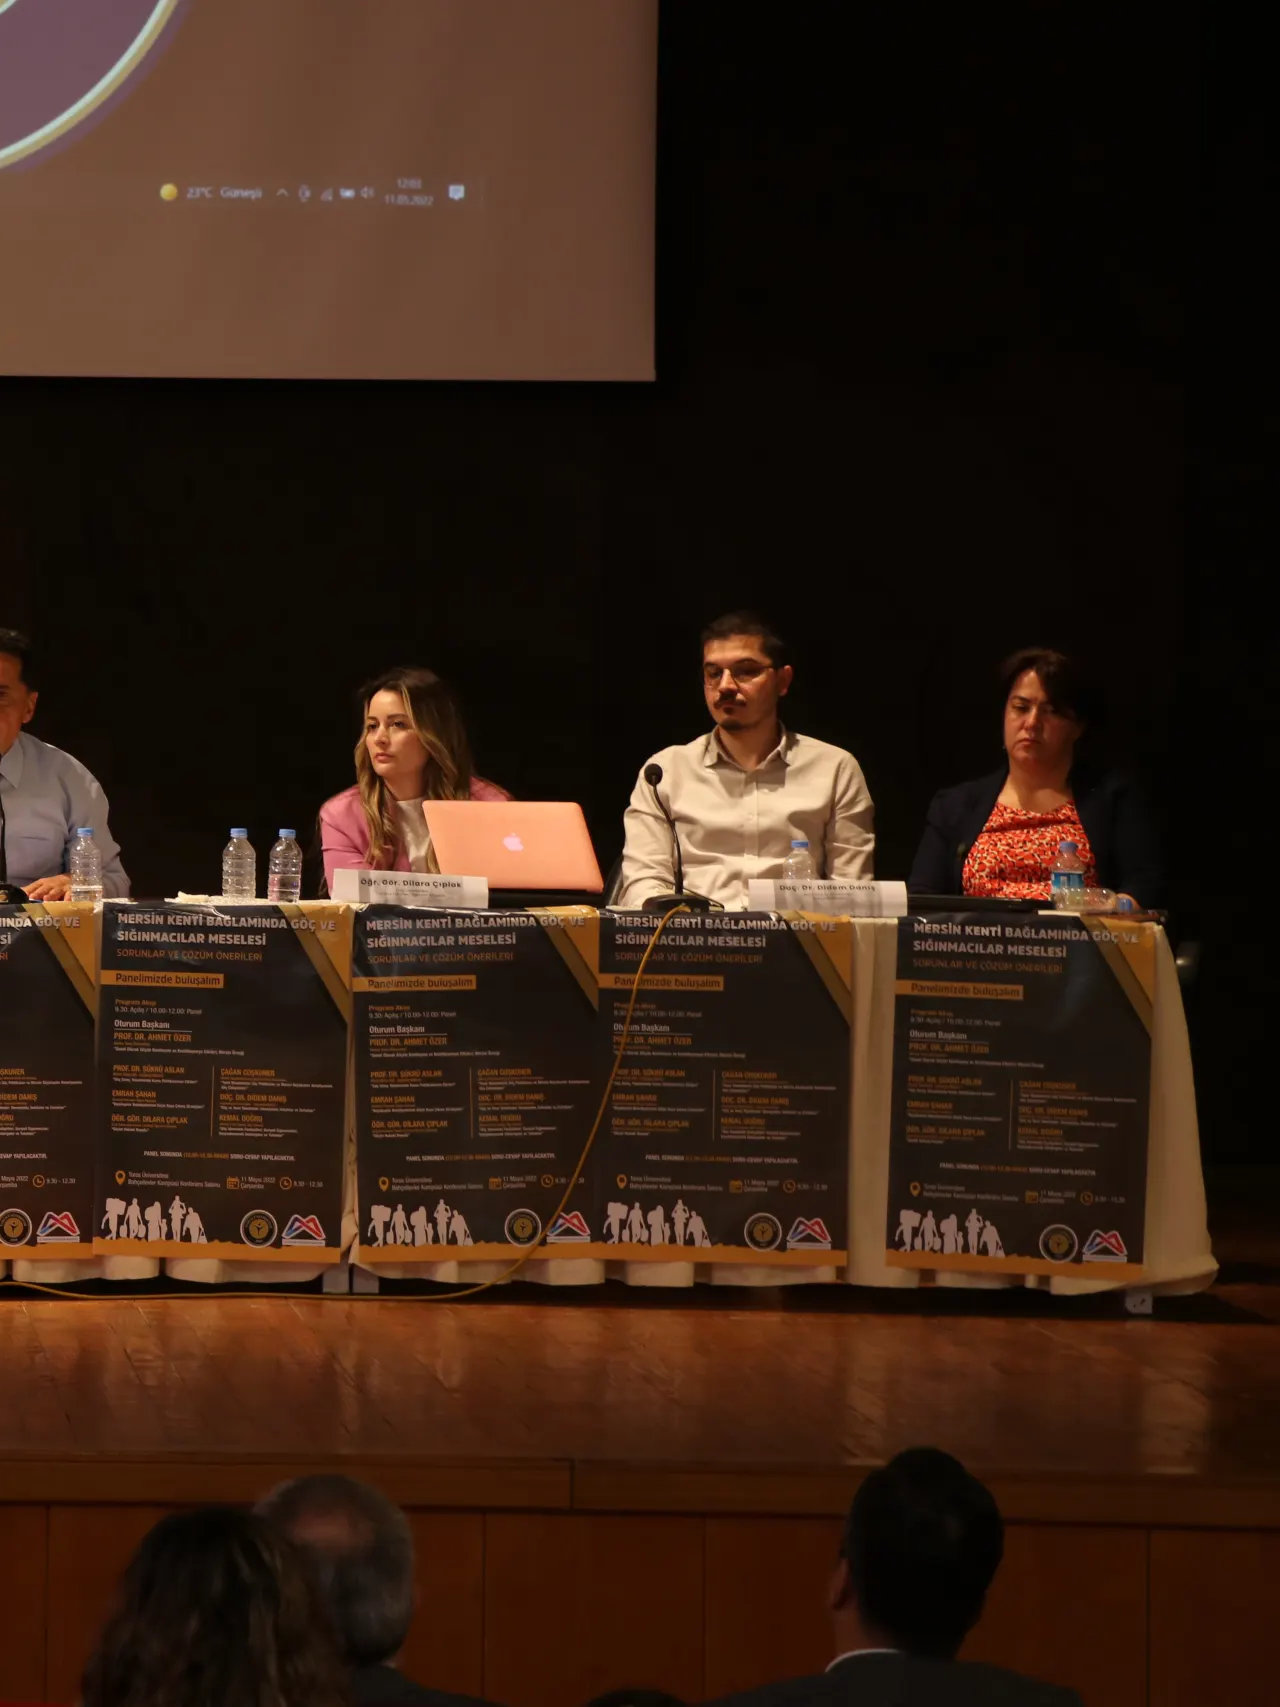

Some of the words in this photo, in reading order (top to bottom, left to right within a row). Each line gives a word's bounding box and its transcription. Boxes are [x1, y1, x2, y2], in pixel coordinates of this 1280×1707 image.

[403, 879, 430, 887] Dilara
[433, 881, 461, 889] Çıplak
[36, 916, 61, 930] GÖÇ
[64, 917, 80, 928] VE
[118, 912, 165, 925] MERSİN
[167, 914, 203, 926] KENTİ
[206, 915, 287, 929] BAĞLAMINDA
[291, 918, 316, 933] GÖÇ
[321, 920, 336, 930] VE
[367, 917, 412, 931] MERSİN
[416, 916, 452, 929] KENTİ
[455, 914, 536, 928] BAĞLAMINDA
[569, 915, 585, 925] VE
[616, 915, 662, 927] MERSİN
[667, 916, 701, 929] KENTİ
[705, 917, 787, 931] BAĞLAMINDA
[791, 919, 816, 933] GÖÇ
[821, 921, 836, 932] VE
[117, 928, 204, 943] SIĞINMACILAR
[208, 932, 266, 945] MESELESİ
[914, 922, 961, 936] MERSİN
[965, 924, 1001, 937] KENTİ
[1005, 925, 1088, 941] BAĞLAMINDA
[367, 934, 455, 948] SIĞINMACILAR
[458, 933, 516, 945] MESELESİ
[707, 935, 766, 947] MESELESİ
[913, 940, 1003, 955] SIĞINMACILAR
[1007, 944, 1066, 957] MESELESİ
[116, 973, 172, 984] Panelimizde
[175, 975, 220, 986] buluşalım
[368, 979, 425, 989] Panelimizde
[428, 978, 473, 988] buluşalım
[675, 978, 720, 989] buluşalım
[911, 983, 970, 994] Panelimizde
[973, 985, 1020, 997] buluşalım
